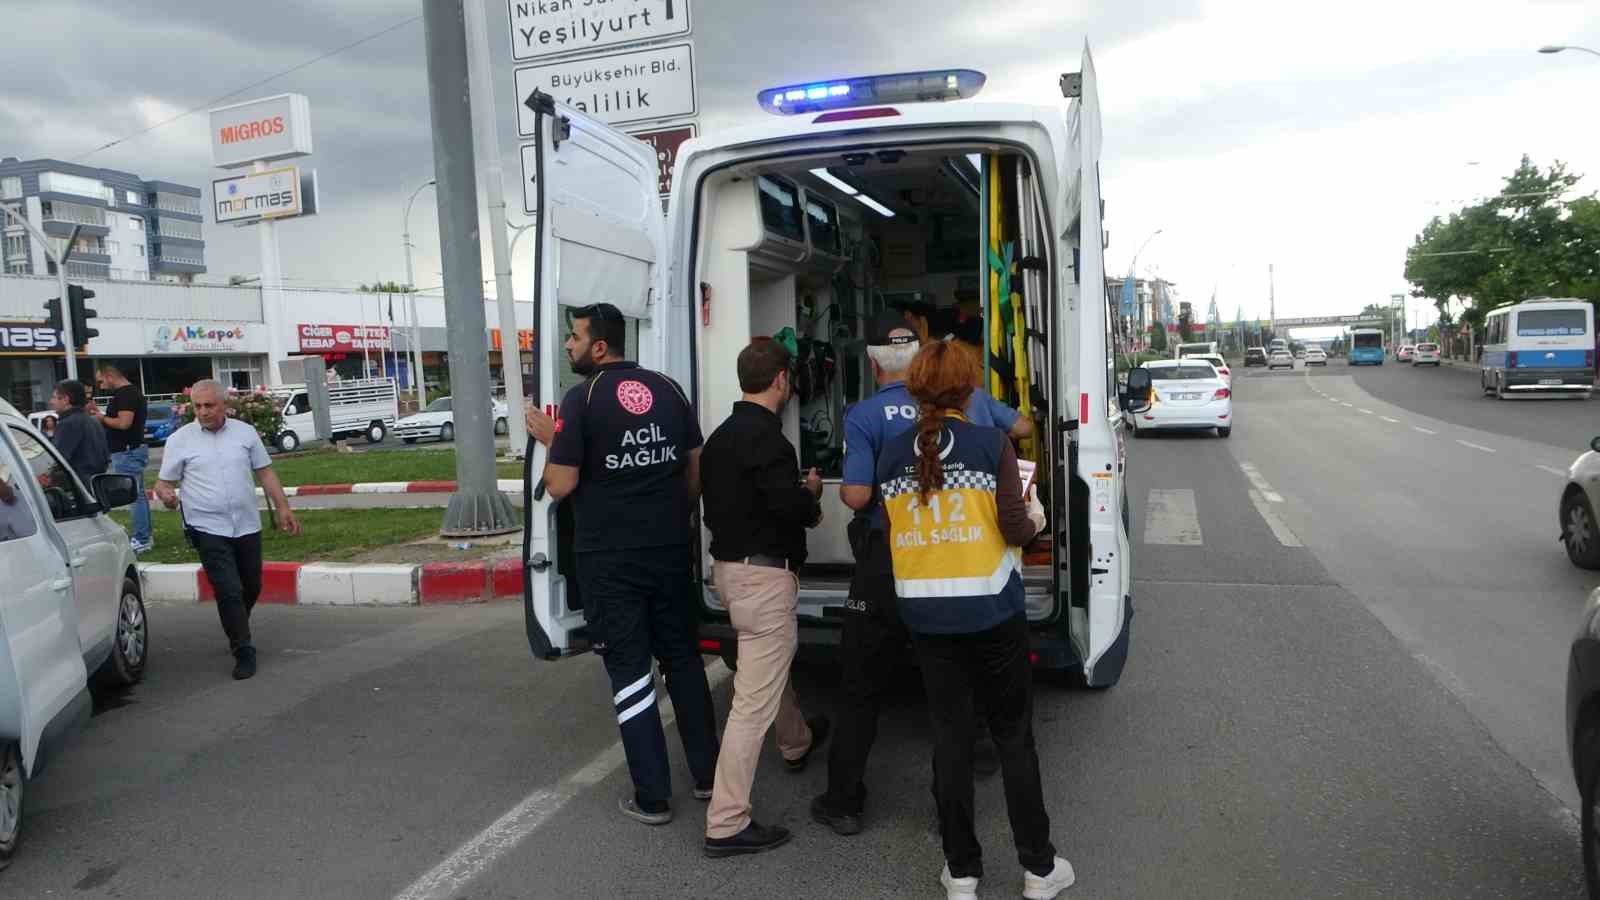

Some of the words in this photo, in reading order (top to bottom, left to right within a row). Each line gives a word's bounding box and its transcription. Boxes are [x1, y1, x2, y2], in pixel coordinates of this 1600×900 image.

[520, 8, 651, 47] Yeşilyurt
[551, 63, 646, 88] Büyükşehir
[651, 59, 681, 74] Bld.
[566, 88, 651, 113] alilik
[173, 325, 244, 342] Ahtapot
[621, 423, 667, 447] ACİL
[605, 445, 677, 470] SAĞLIK
[907, 492, 966, 526] 112
